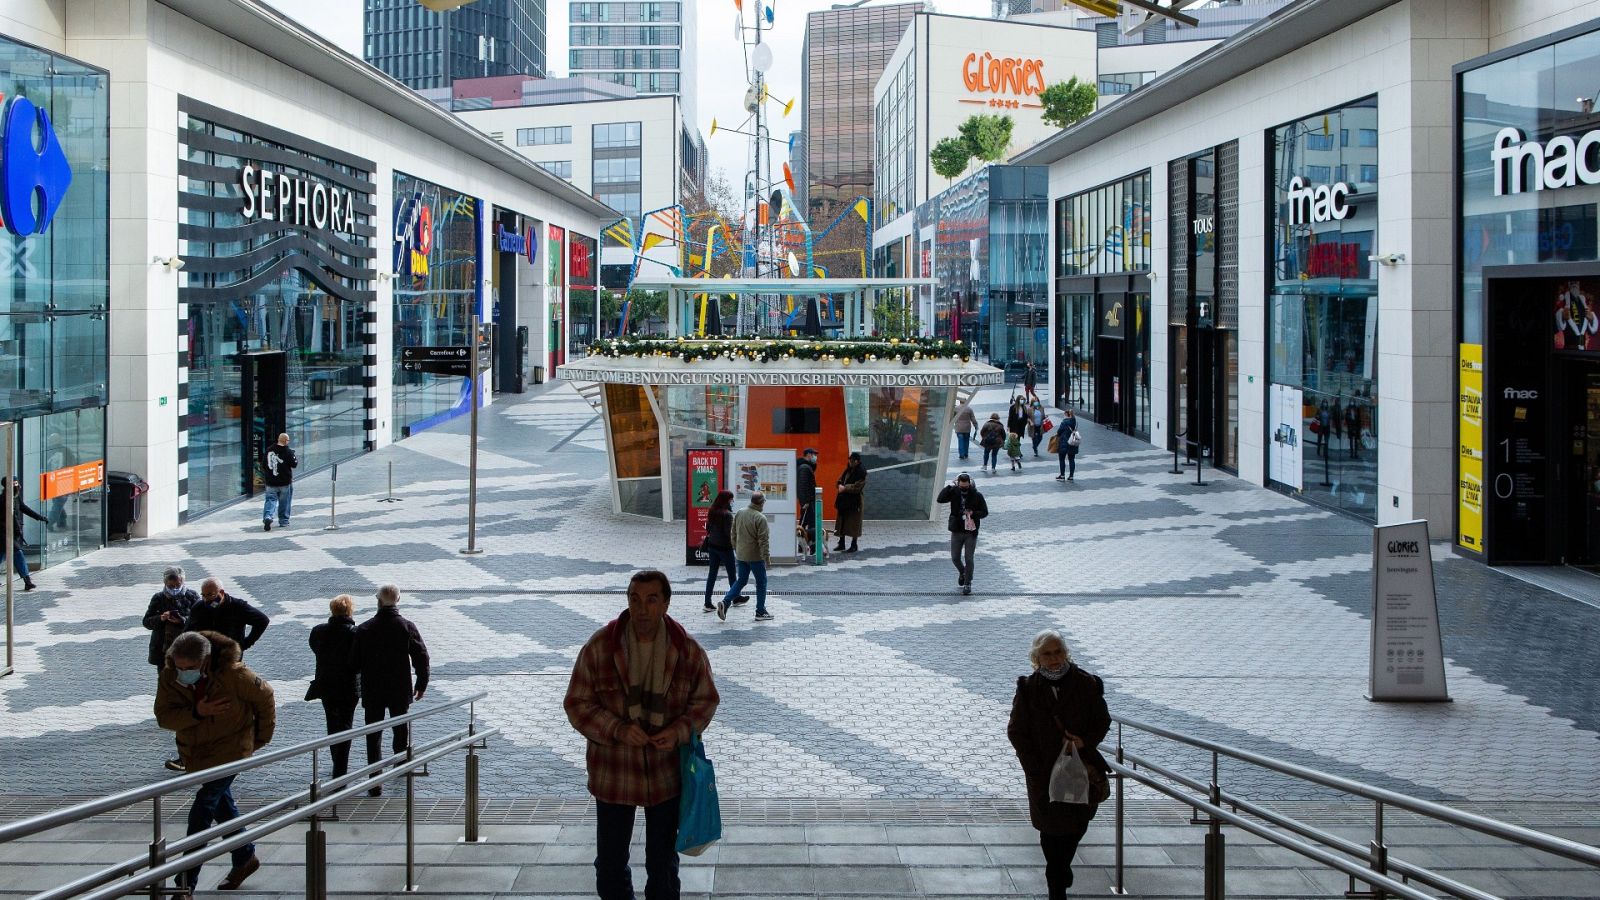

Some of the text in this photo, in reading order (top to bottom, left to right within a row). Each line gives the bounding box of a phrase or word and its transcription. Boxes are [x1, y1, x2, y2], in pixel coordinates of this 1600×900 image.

[1490, 127, 1600, 197] fnac
[241, 165, 355, 234] SEPHORA
[1287, 176, 1349, 225] fnac
[1193, 217, 1213, 235] TOUS
[410, 249, 429, 276] DRIM
[1503, 386, 1538, 399] fnac
[692, 457, 718, 466] BACK TO
[1499, 438, 1509, 464] 1
